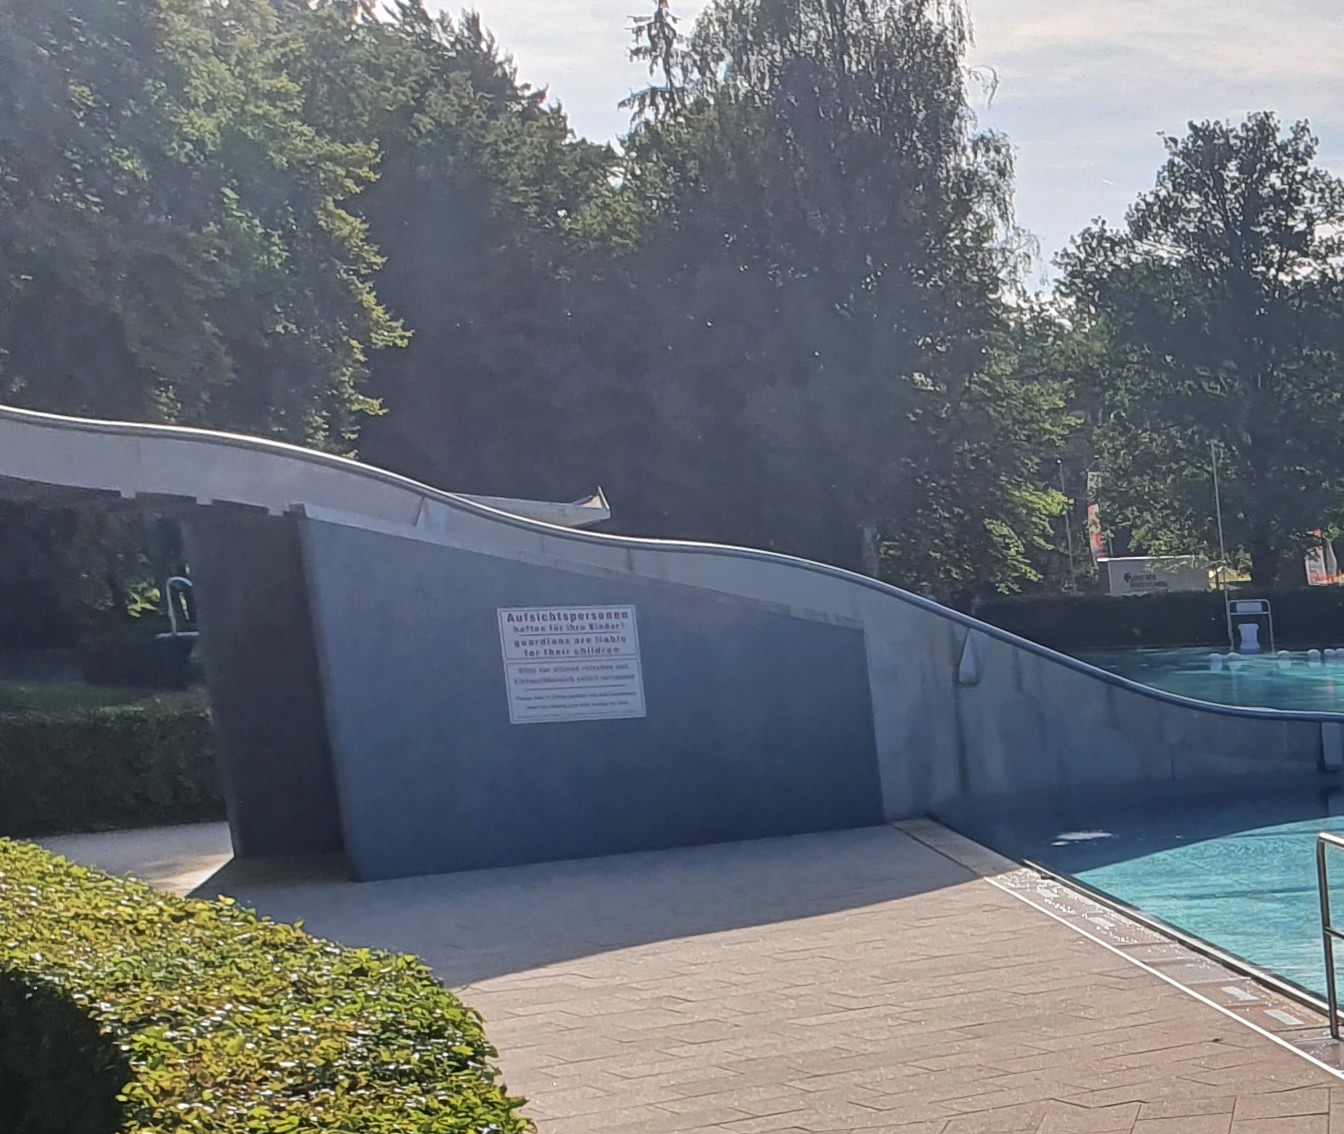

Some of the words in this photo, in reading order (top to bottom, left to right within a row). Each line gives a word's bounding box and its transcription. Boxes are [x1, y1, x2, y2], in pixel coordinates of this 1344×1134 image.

[507, 611, 629, 623] Aufsichtspersonen
[513, 625, 546, 633] haften
[514, 637, 570, 648] guardians
[574, 637, 591, 645] are
[595, 635, 627, 644] liable
[524, 649, 539, 657] for
[544, 648, 570, 656] their
[574, 646, 620, 655] children
